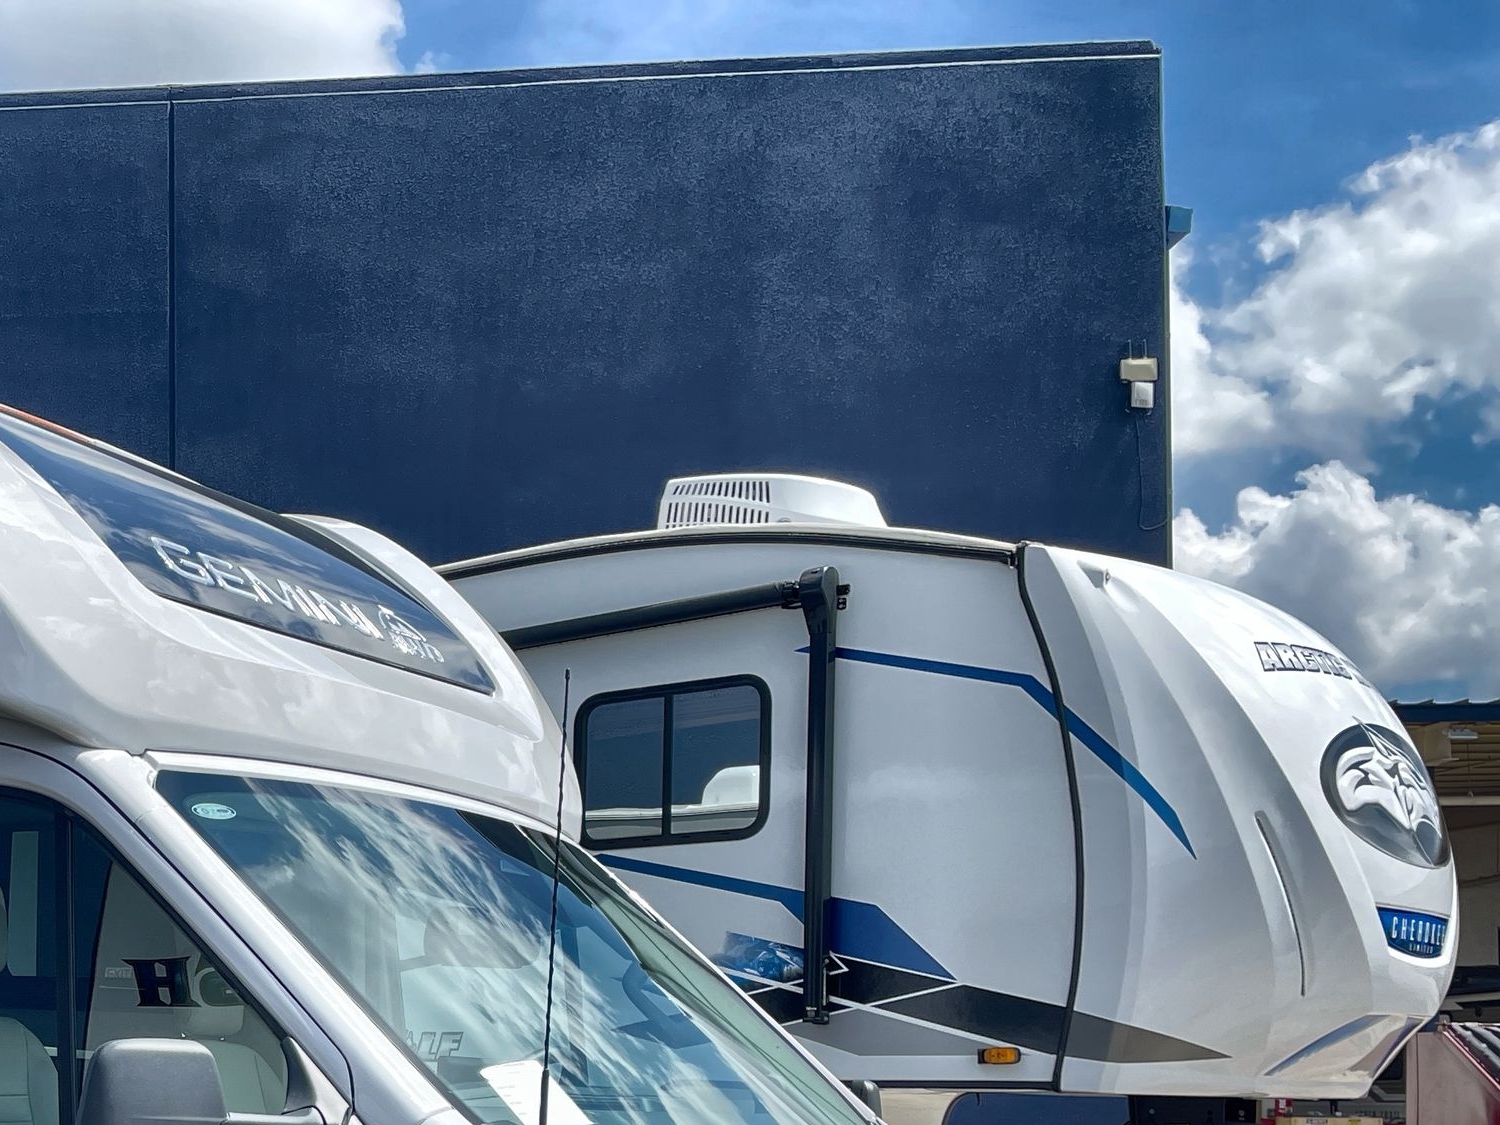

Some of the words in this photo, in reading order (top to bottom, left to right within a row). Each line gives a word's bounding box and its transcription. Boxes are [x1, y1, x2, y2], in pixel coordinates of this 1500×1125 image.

[150, 536, 385, 640] GEMINI
[1253, 641, 1352, 680] ARCTIC
[1391, 916, 1446, 946] CHEROKEE
